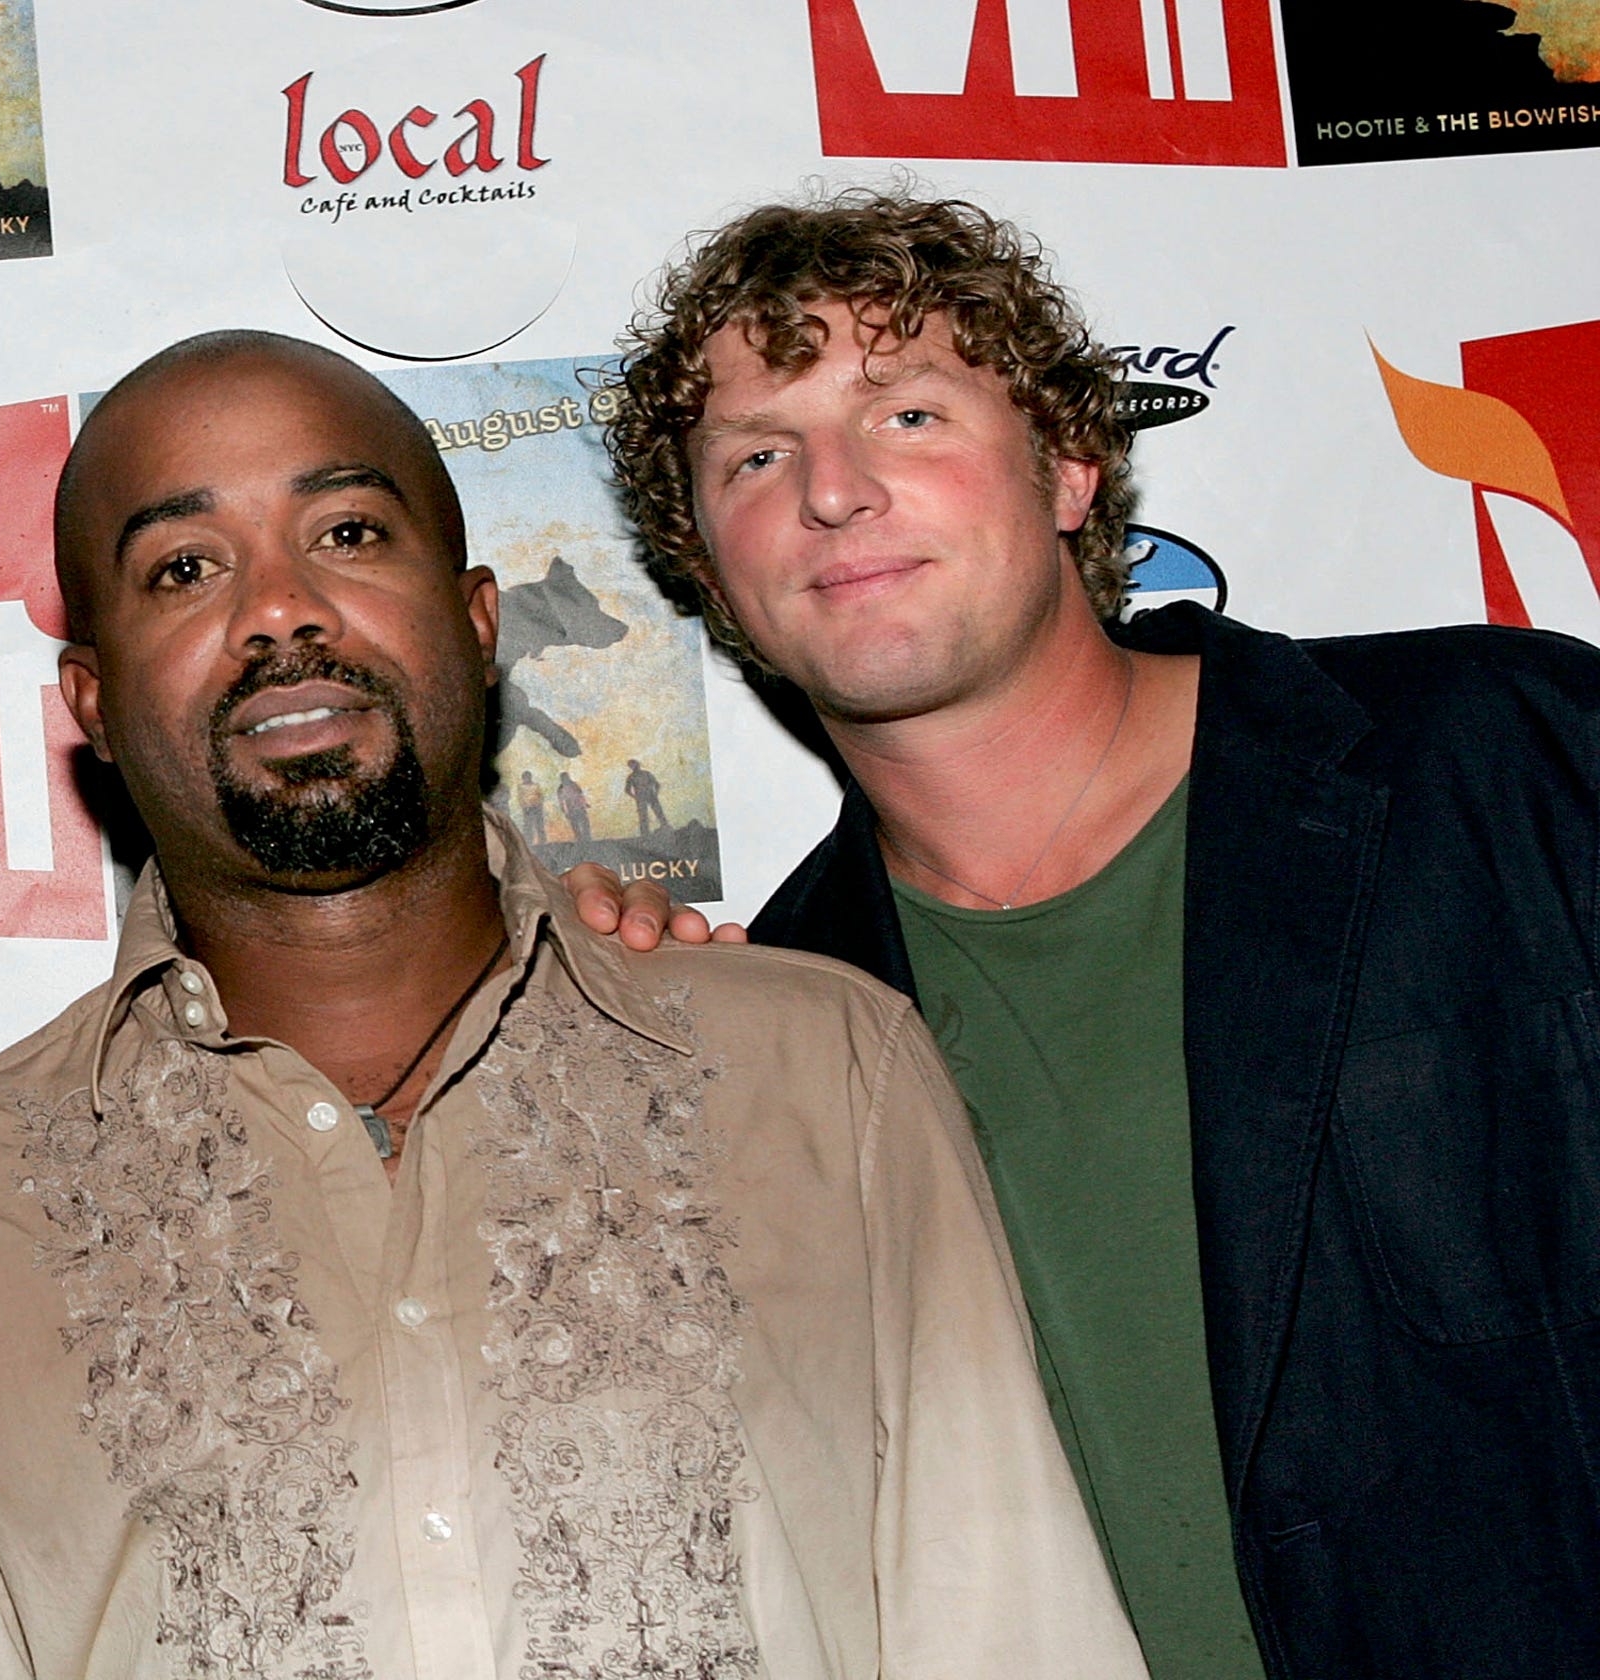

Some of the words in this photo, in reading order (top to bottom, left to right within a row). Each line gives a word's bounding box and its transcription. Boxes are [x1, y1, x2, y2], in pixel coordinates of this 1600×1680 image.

[281, 53, 551, 187] local
[1317, 118, 1405, 140] HOOTIE
[1415, 116, 1430, 133] &
[1436, 112, 1480, 132] THE
[338, 143, 363, 153] NYC
[300, 192, 357, 223] Café
[365, 190, 413, 212] and
[418, 181, 536, 205] Cocktails
[1115, 395, 1202, 413] RECORDS
[423, 397, 582, 451] August
[590, 388, 620, 424] 9
[619, 859, 699, 882] LUCKY
